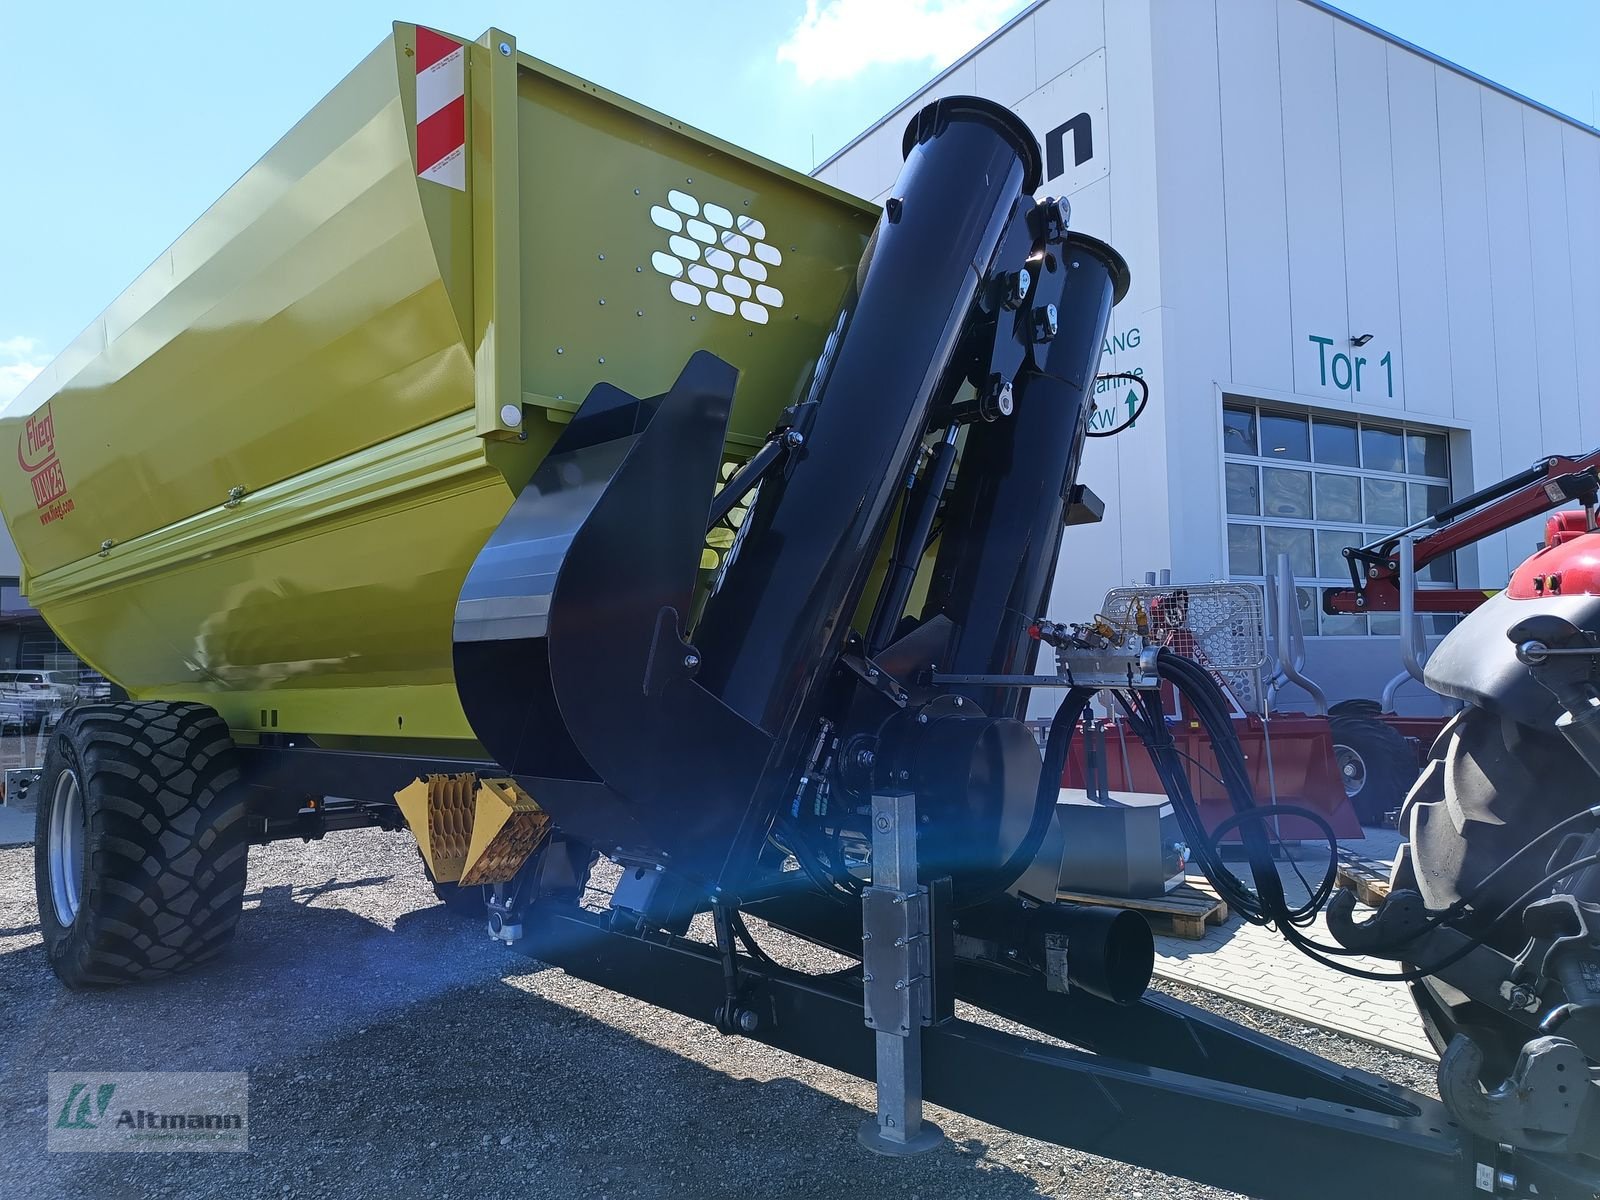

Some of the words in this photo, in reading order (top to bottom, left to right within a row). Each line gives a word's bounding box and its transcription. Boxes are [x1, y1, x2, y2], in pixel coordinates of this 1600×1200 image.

[1309, 334, 1367, 393] Tor
[1380, 351, 1393, 398] 1
[26, 402, 55, 456] Fliegl
